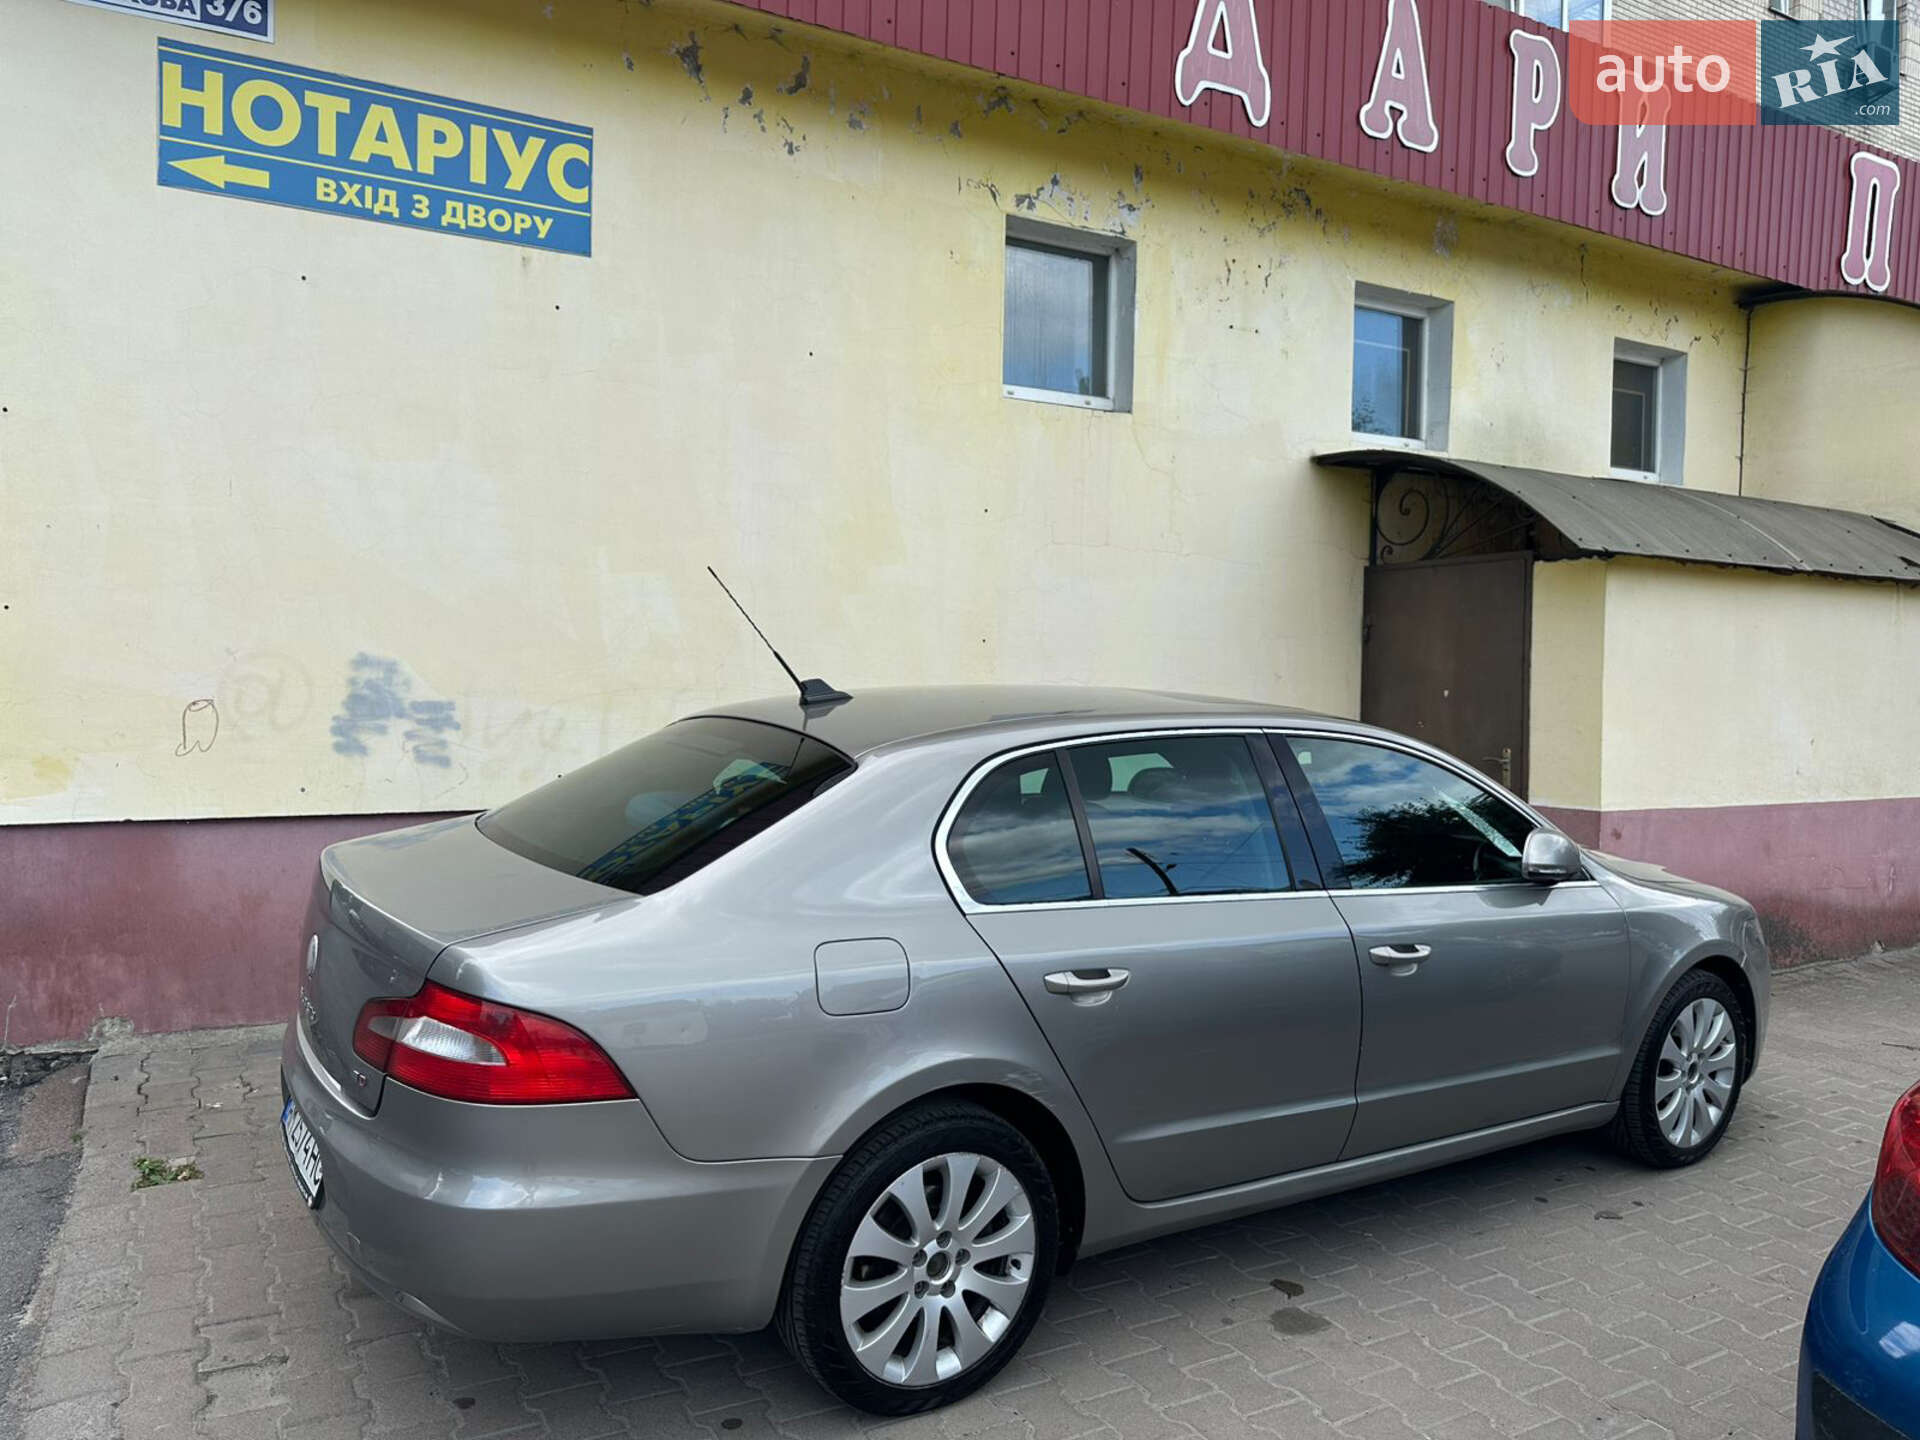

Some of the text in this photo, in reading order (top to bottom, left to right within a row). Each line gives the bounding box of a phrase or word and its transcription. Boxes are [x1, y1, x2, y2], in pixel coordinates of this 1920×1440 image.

[206, 0, 262, 24] 3/6
[161, 61, 590, 204] НОТАРІУС
[315, 176, 400, 218] ВХІД
[440, 200, 554, 239] ДВОРУ
